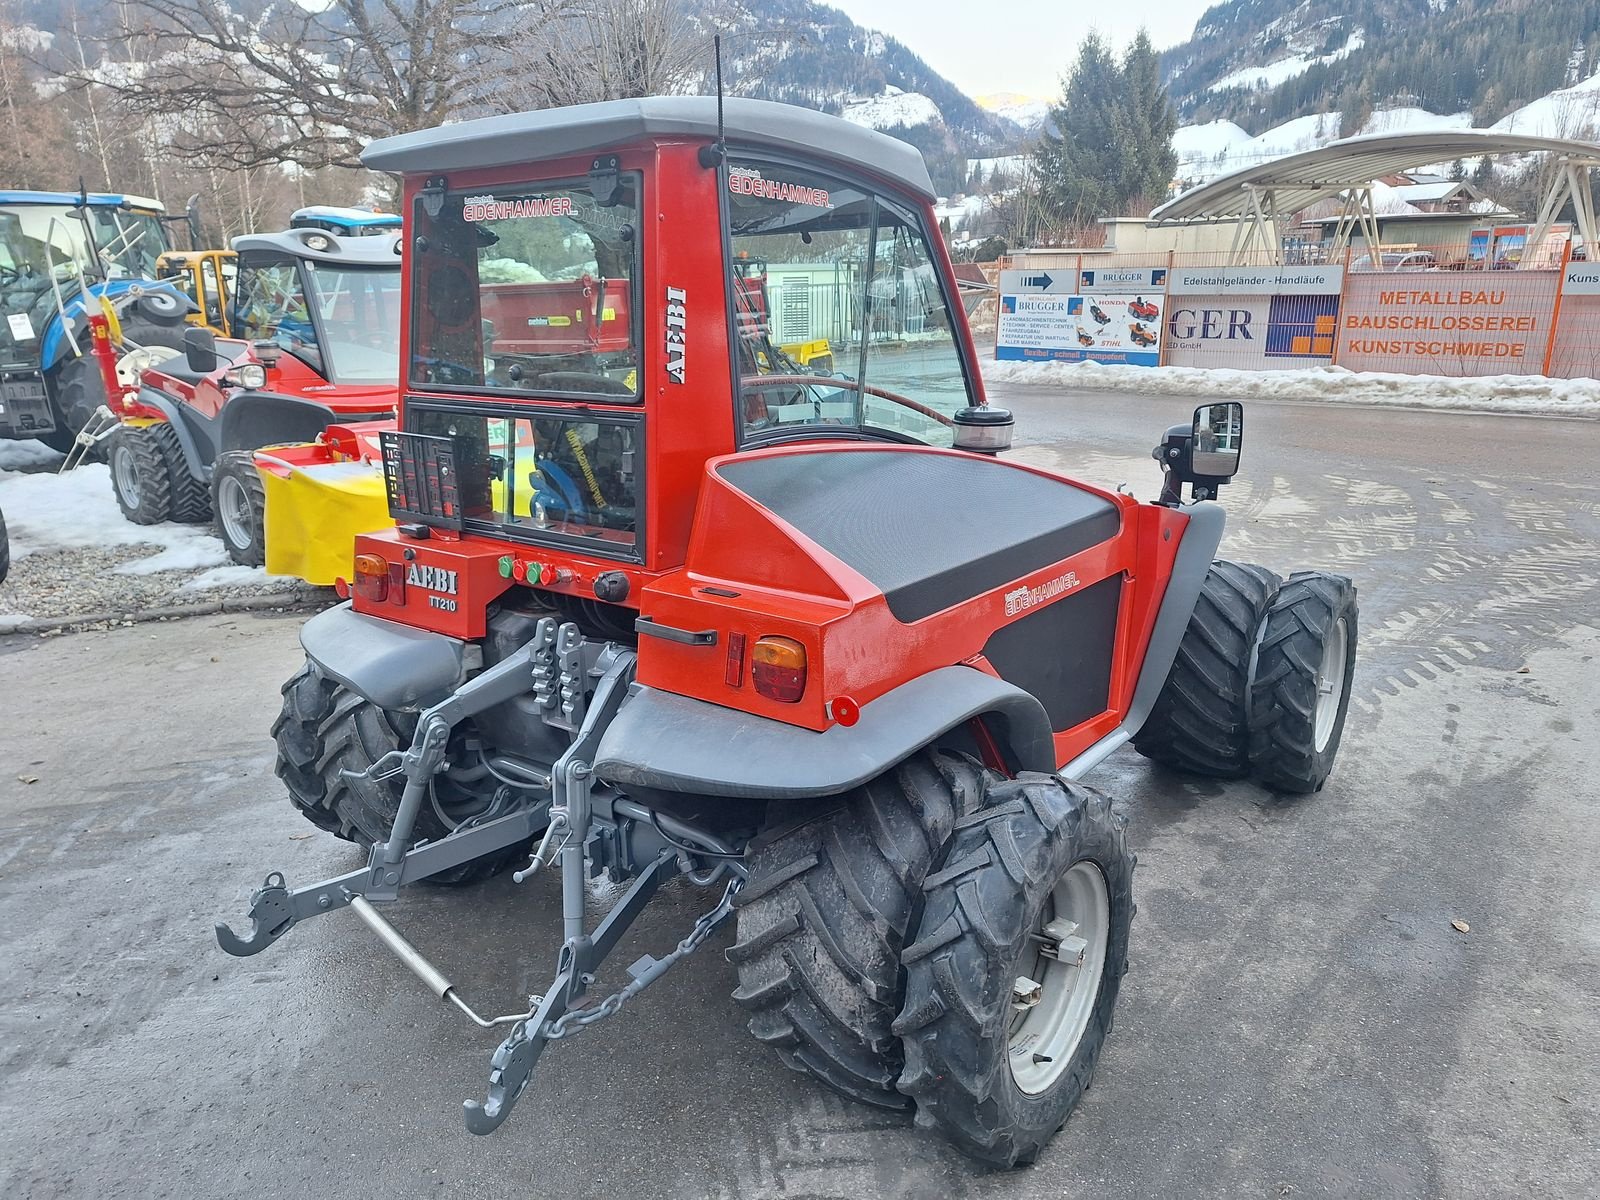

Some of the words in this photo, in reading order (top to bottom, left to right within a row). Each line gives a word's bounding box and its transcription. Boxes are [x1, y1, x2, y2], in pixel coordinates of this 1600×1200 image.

[729, 175, 829, 208] EIDENHAMMER
[463, 197, 572, 222] EIDENHAMMER
[1103, 273, 1142, 281] BRUGGER
[1183, 275, 1266, 287] Edelstahlgeländer
[1274, 275, 1325, 285] Handläufe
[1567, 273, 1599, 283] Kuns
[1379, 290, 1506, 305] METALLBAU
[1019, 302, 1064, 311] BRUGGER
[1169, 309, 1254, 339] GER
[1346, 315, 1537, 332] BAUSCHLOSSEREI
[666, 286, 687, 384] AEBI
[1348, 340, 1525, 357] KUNSTSCHMIEDE
[406, 563, 457, 594] AEBI
[1006, 572, 1076, 616] EIDENHAMMER
[428, 596, 457, 611] TT210
